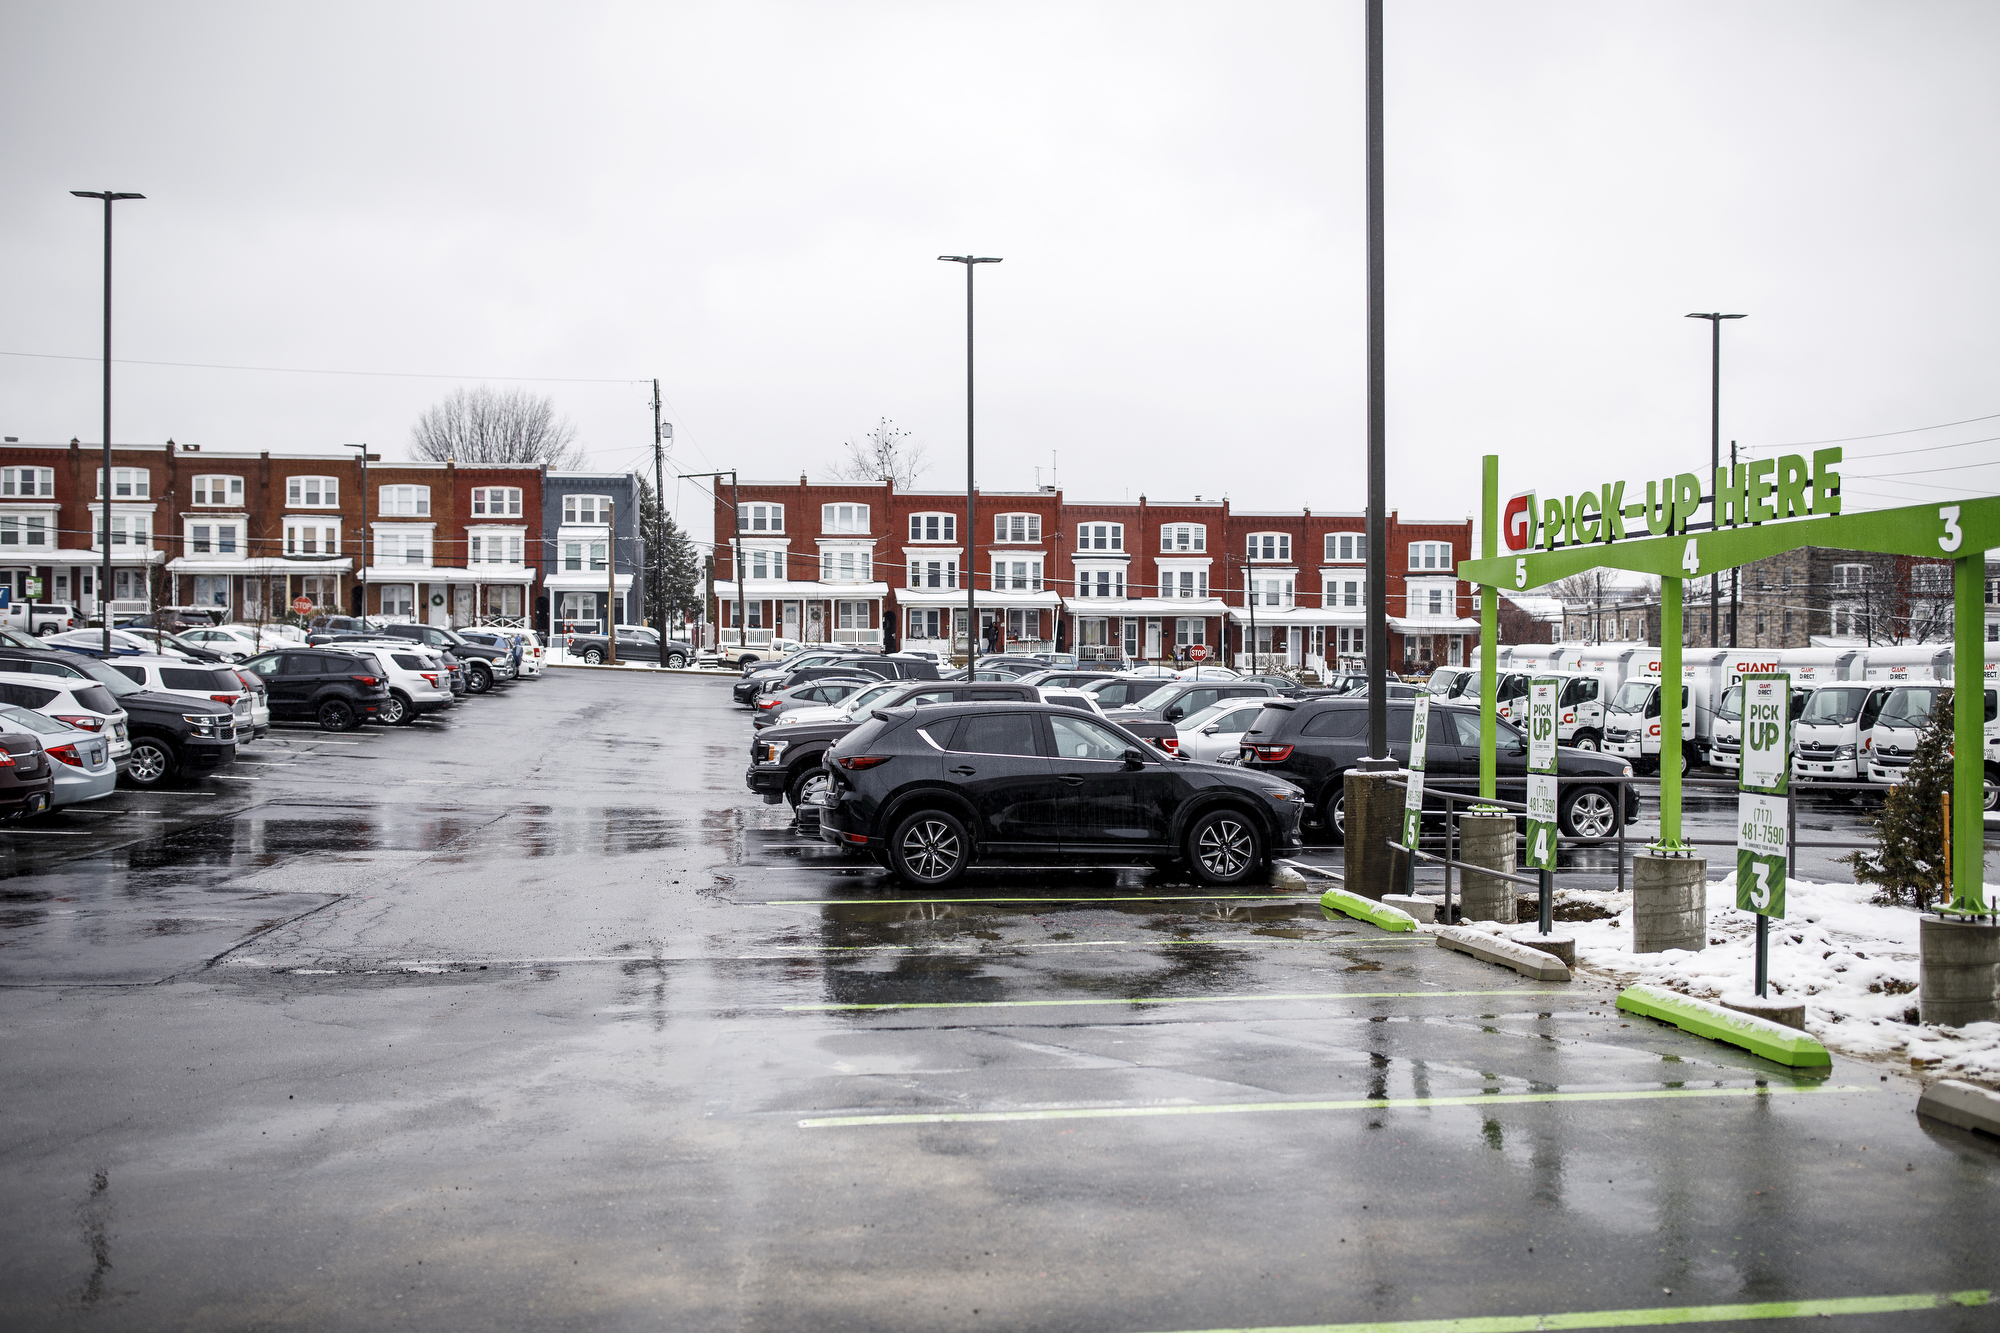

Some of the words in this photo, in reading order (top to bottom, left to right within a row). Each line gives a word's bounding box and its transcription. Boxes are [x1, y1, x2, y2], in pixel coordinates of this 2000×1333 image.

[1543, 472, 1701, 549] PICK-UP
[1715, 446, 1843, 526] HERE
[1938, 505, 1963, 552] 3
[1682, 538, 1700, 575] 4
[1515, 558, 1527, 588] 5
[294, 601, 312, 610] STOP
[1191, 649, 1206, 657] STOP
[1736, 663, 1778, 673] GIANT
[1533, 704, 1552, 717] PICK
[1563, 713, 1574, 723] G
[1750, 704, 1779, 721] PICK
[1414, 724, 1425, 744] UP
[1533, 718, 1552, 741] UP
[1749, 722, 1779, 751] UP
[1536, 785, 1549, 797] (717)
[1529, 797, 1556, 814] 481-7590
[1753, 807, 1773, 825] (717)
[1407, 815, 1416, 846] 5
[1741, 822, 1785, 846] 481-7590
[1534, 828, 1549, 865] 4
[1750, 861, 1771, 909] 3
